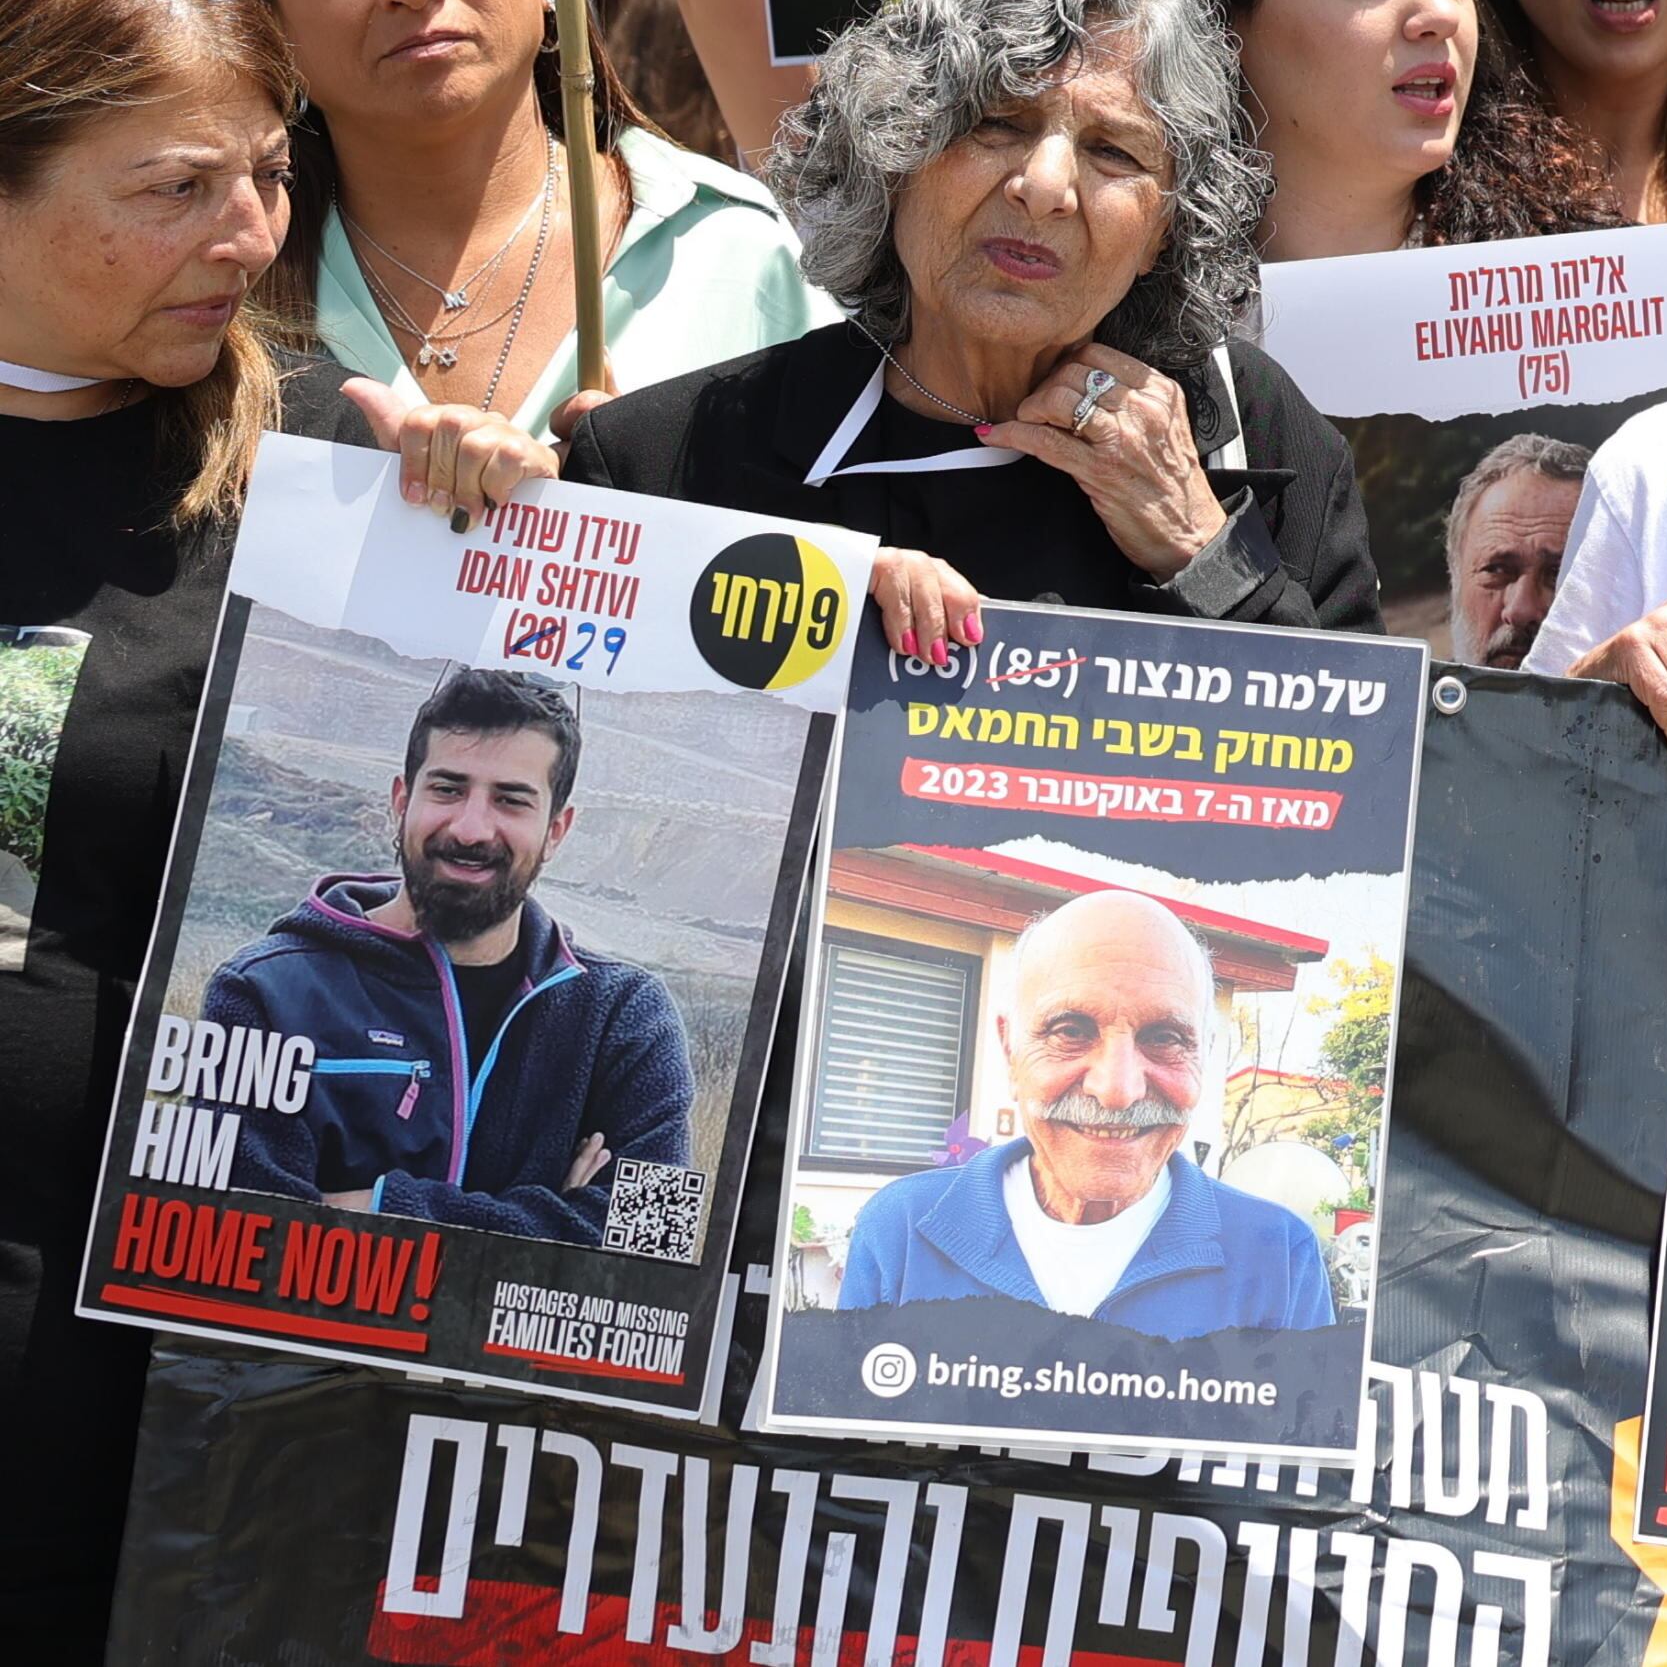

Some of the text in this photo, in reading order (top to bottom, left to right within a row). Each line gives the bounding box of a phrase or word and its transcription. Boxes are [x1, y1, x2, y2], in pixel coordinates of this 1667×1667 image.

[1448, 255, 1628, 312] אליהו מרגלית
[1415, 296, 1665, 361] ELIYAHU MARGALIT
[1517, 350, 1571, 399] (75)
[573, 515, 642, 565] עידן
[456, 549, 641, 620] IDAN SHTIVI
[710, 572, 841, 650] 9 ירחי
[566, 622, 628, 676] 29
[988, 641, 1080, 698] (85)
[1095, 655, 1232, 703] מנצור
[1245, 669, 1386, 716] שלמה
[907, 703, 1354, 773] מוחזק בשבי החמאס
[919, 765, 1009, 800] 2023
[1018, 775, 1183, 817] באוקטובר
[1261, 796, 1330, 827] מאז
[146, 1015, 316, 1115] BRING
[129, 1100, 241, 1191] HIM
[112, 1191, 443, 1321] HOME NOW!
[494, 1280, 688, 1339] HOSTAGES AND MISSING
[488, 1308, 685, 1377] FAMILIES FORUM
[927, 1352, 1278, 1408] bring.shlomo.home
